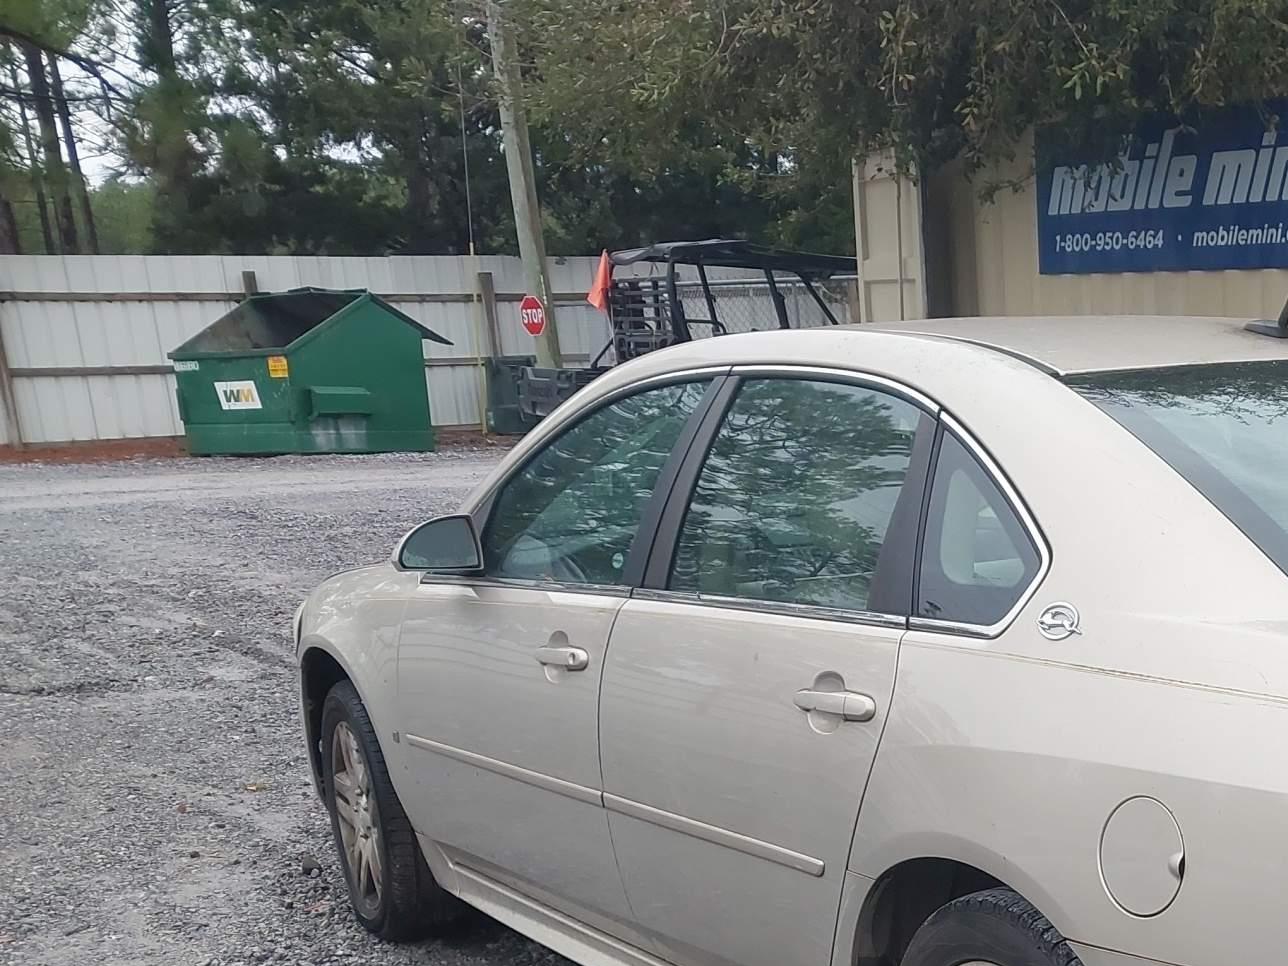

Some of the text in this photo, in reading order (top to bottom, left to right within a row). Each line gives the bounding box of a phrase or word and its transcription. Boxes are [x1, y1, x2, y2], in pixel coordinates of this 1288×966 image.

[1048, 129, 1198, 215] mobile
[1055, 229, 1164, 253] 1-800-950-6464
[522, 308, 542, 324] STOP
[222, 388, 255, 403] WM
